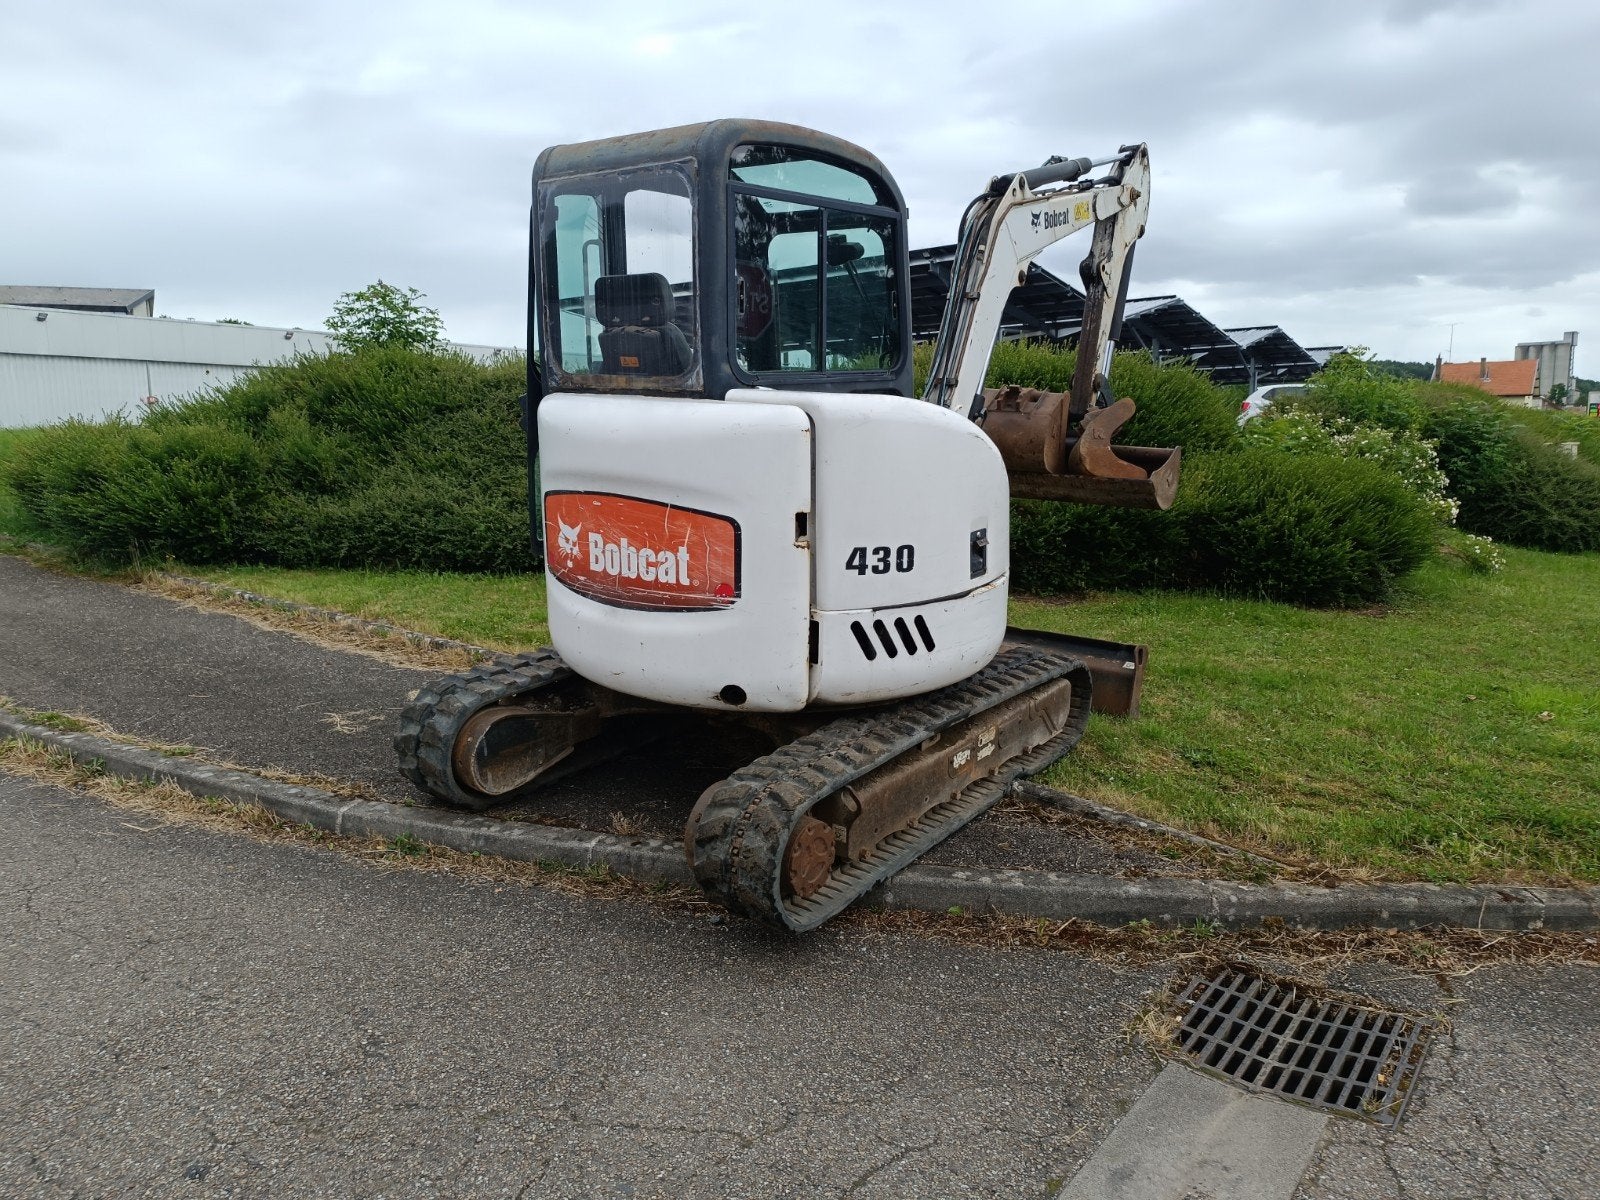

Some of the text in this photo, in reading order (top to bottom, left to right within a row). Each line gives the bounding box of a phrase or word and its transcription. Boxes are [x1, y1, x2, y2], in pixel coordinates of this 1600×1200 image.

[1044, 208, 1070, 230] Bobcat
[588, 532, 690, 586] Bobcat
[845, 544, 915, 576] 430
